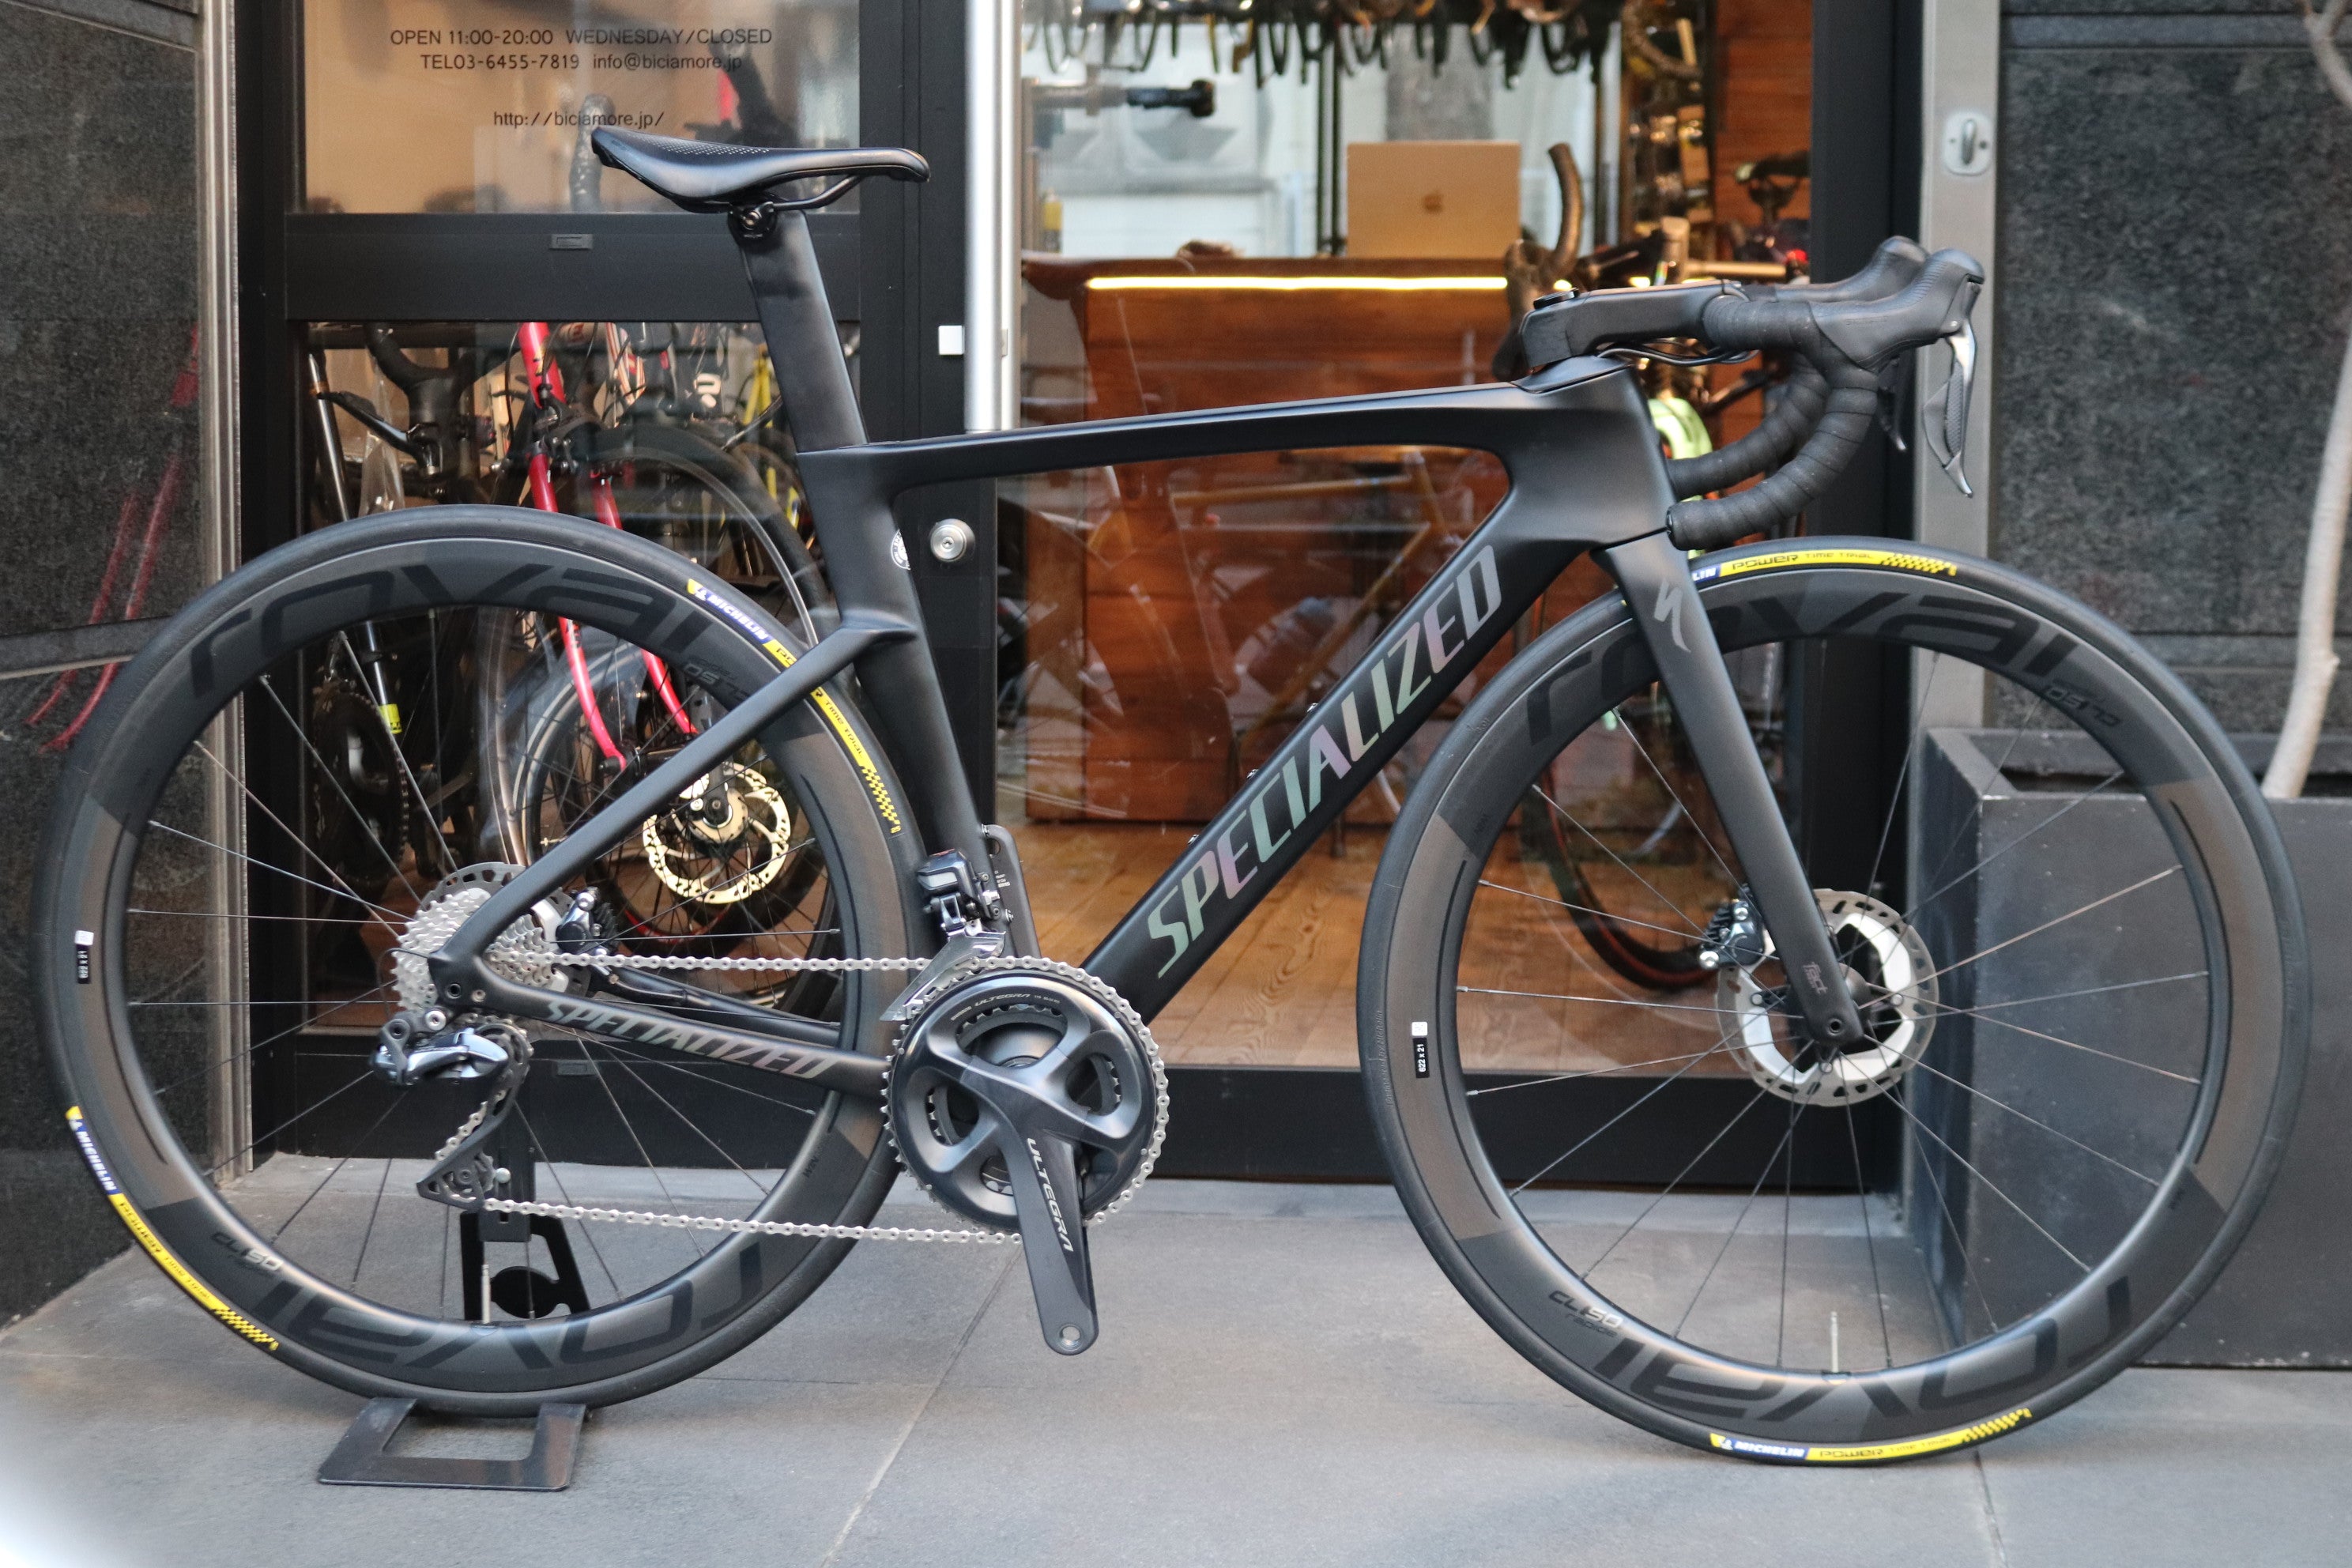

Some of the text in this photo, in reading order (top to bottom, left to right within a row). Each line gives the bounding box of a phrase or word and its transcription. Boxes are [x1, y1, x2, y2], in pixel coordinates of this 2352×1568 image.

[390, 28, 772, 45] OPEN 11:00-20:00 WEDNESDAY/CLOSED
[420, 52, 742, 72] TEL03-6455-7819 info@biciamore.jp
[493, 111, 664, 129] http://biciamore.jp/
[1732, 554, 1799, 570] POWER
[707, 594, 770, 641] MICHELIN
[1148, 545, 1502, 978] SPECIALIZED
[548, 1001, 839, 1080] SPECIALIZED
[1416, 1043, 1425, 1053] 21
[1417, 1058, 1427, 1072] 622
[77, 1131, 117, 1192] MICHELIN
[1027, 1137, 1074, 1252] ULTEGRA
[1736, 1442, 1805, 1457] MICHELIN
